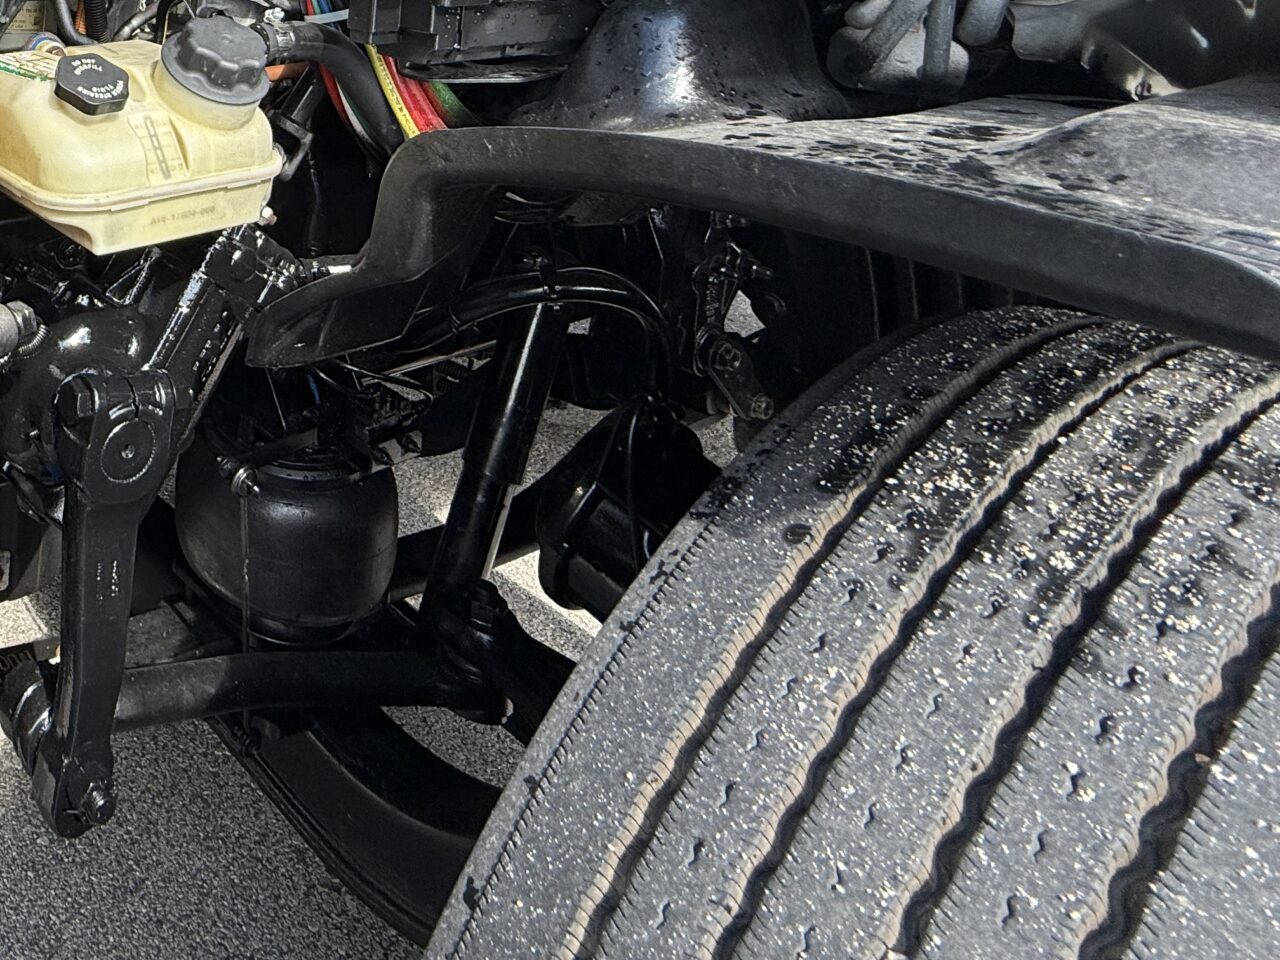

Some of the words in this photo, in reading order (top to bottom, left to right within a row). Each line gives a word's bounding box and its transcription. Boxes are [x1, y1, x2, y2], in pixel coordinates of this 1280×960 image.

[71, 59, 81, 67] DO
[74, 63, 103, 75] OVERFILL
[77, 86, 113, 99] STEERING
[91, 84, 114, 93] FLUID
